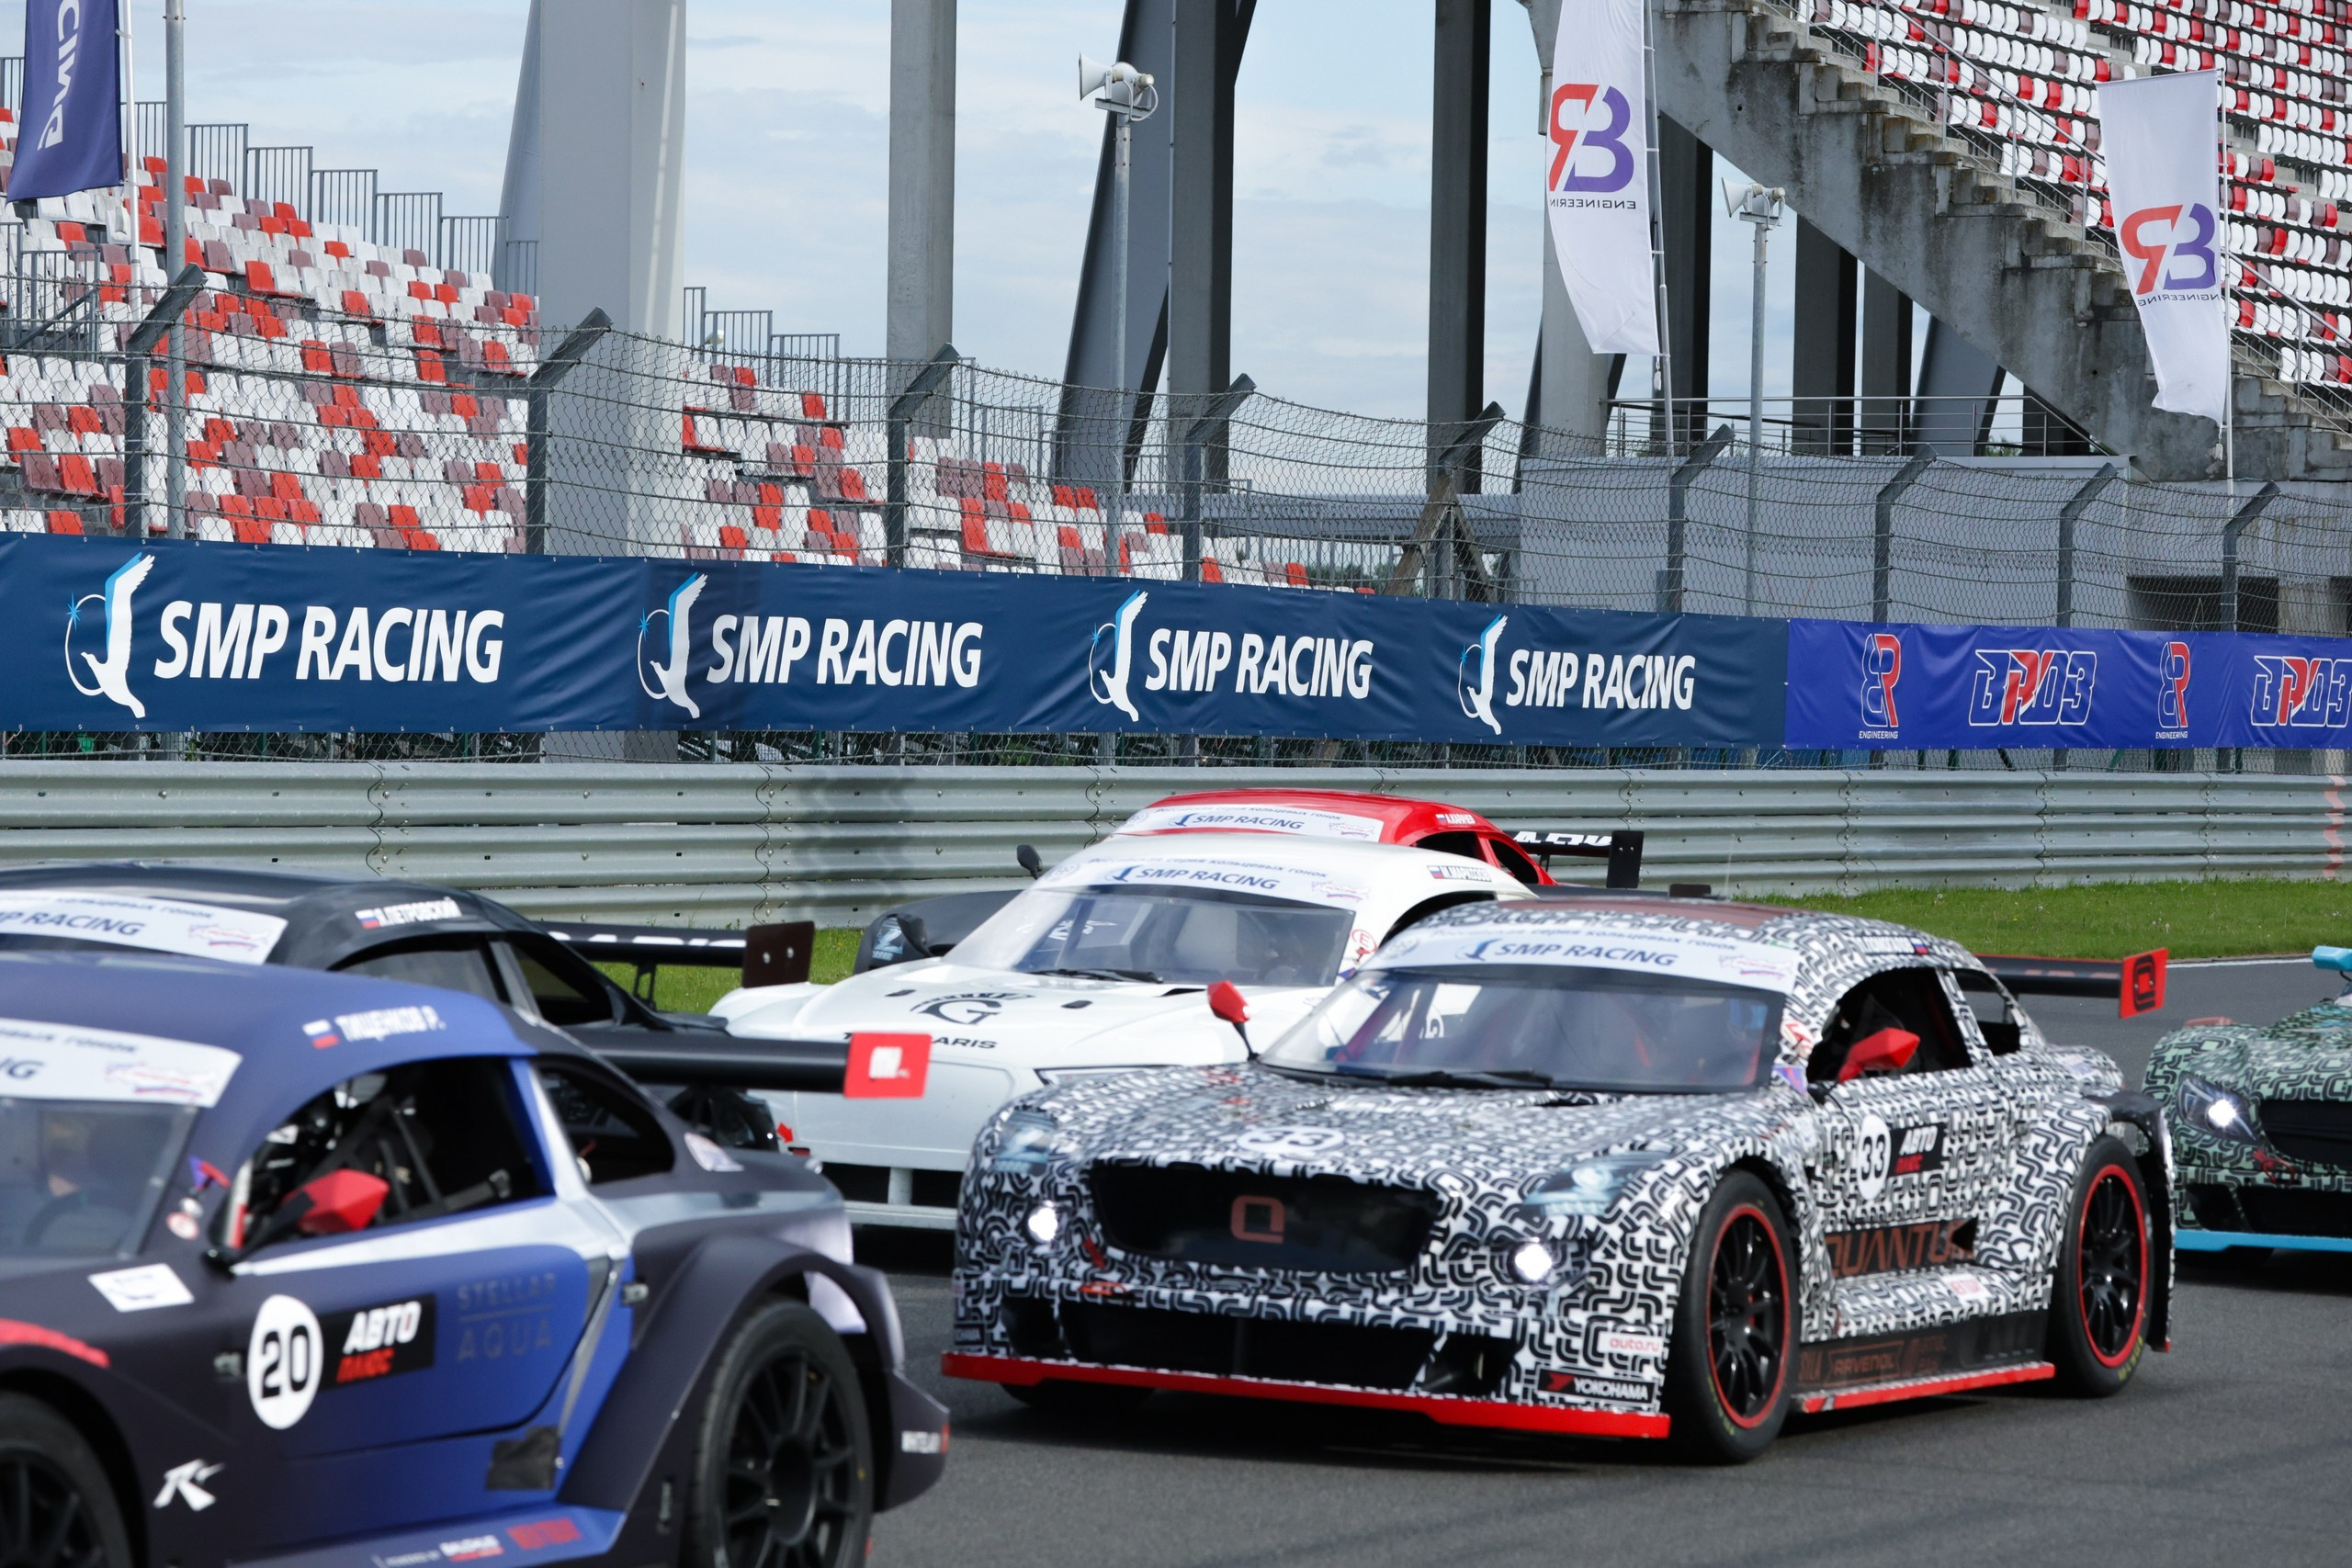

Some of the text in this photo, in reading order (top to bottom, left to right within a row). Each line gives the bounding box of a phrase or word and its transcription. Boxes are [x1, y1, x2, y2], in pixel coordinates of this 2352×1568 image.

[154, 601, 503, 682] SMP RACING
[707, 615, 982, 687] SMP RACING
[1145, 628, 1374, 699] SMP RACING
[1506, 649, 1695, 710] SMP RACING
[1859, 730, 1899, 740] ENGINEERING
[2154, 730, 2188, 740] ENGINEERING
[1193, 815, 1305, 829] SMP RACING
[1136, 867, 1281, 890] SMP RACING
[21, 911, 145, 936] RACING
[1495, 942, 1679, 965] SMP RACING
[1861, 1134, 1885, 1181] 33
[457, 1317, 552, 1363] AQUA
[1610, 1337, 1659, 1353] auto.ru
[261, 1325, 311, 1399] 20
[1574, 1377, 1648, 1400] YOKOHAMA
